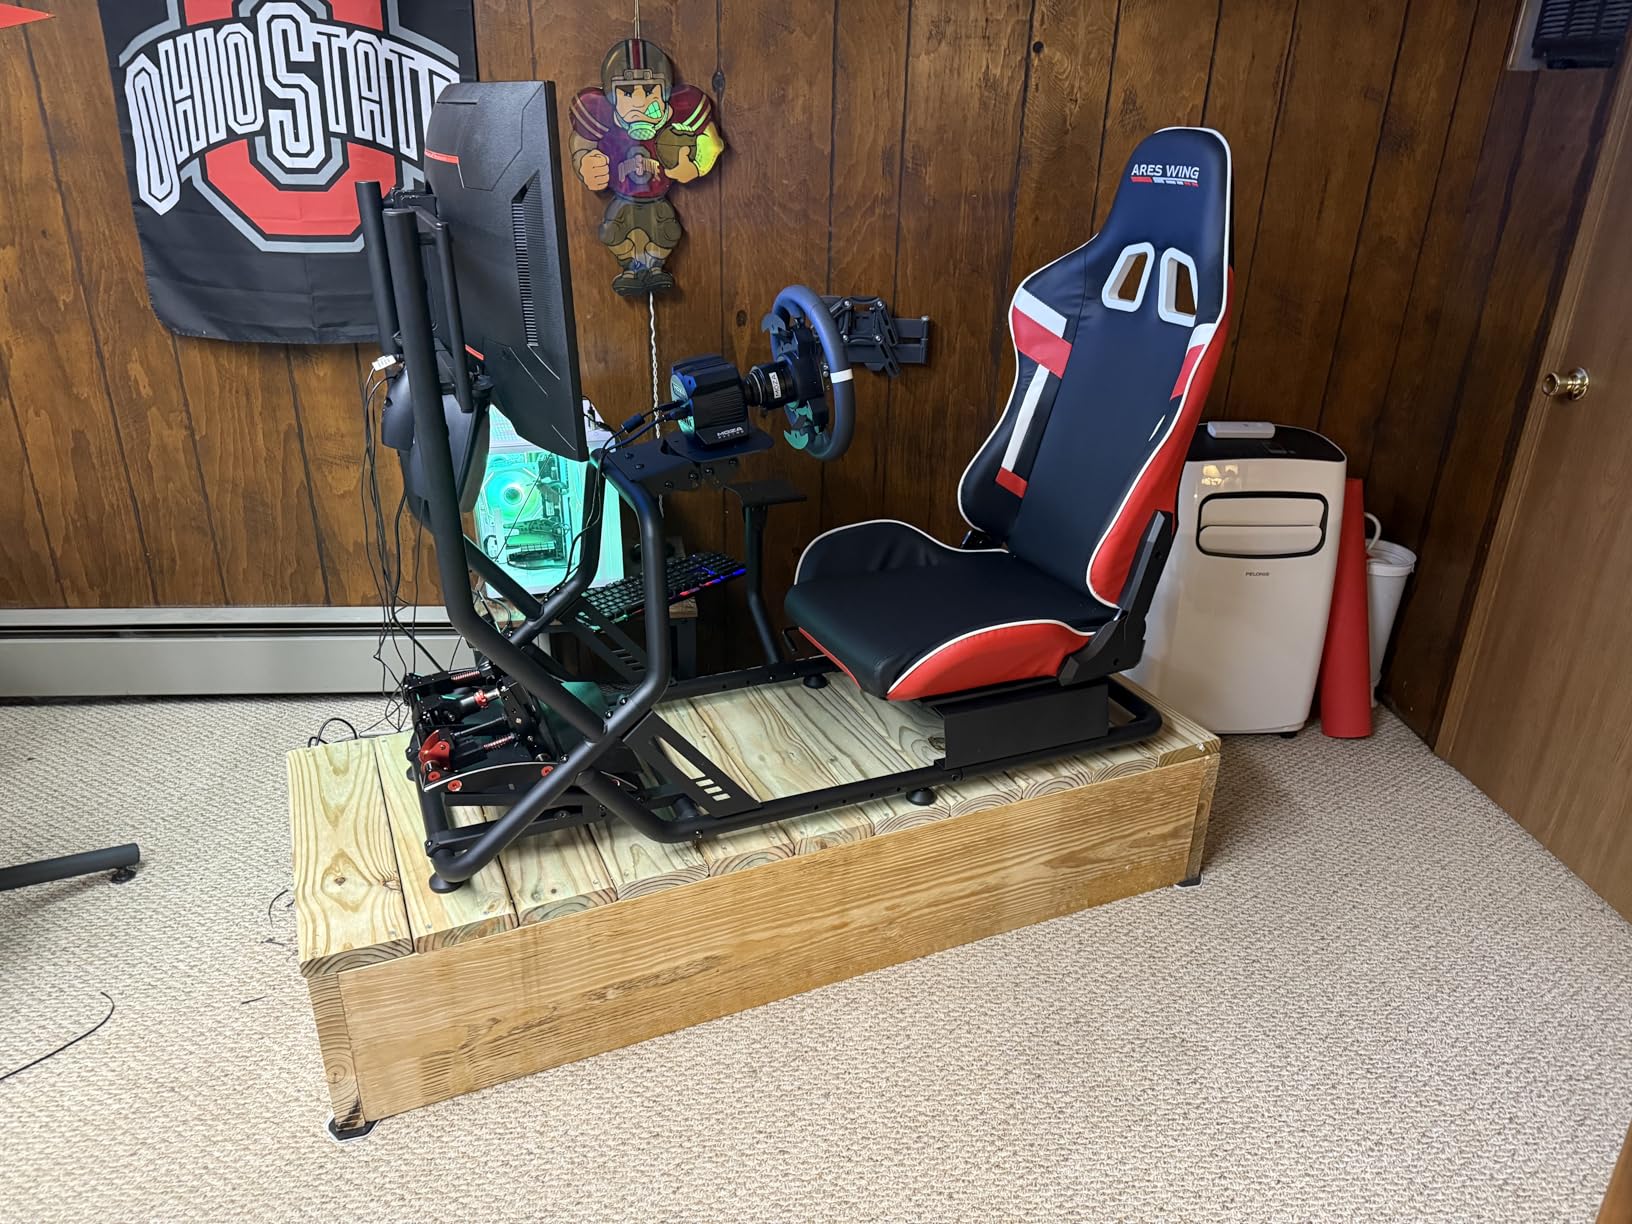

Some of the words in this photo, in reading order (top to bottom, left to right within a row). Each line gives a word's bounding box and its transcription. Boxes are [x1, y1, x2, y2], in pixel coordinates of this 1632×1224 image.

[124, 22, 264, 216] OHIO
[1131, 164, 1163, 176] ARES
[1165, 165, 1200, 179] WING
[770, 374, 781, 398] MOZA
